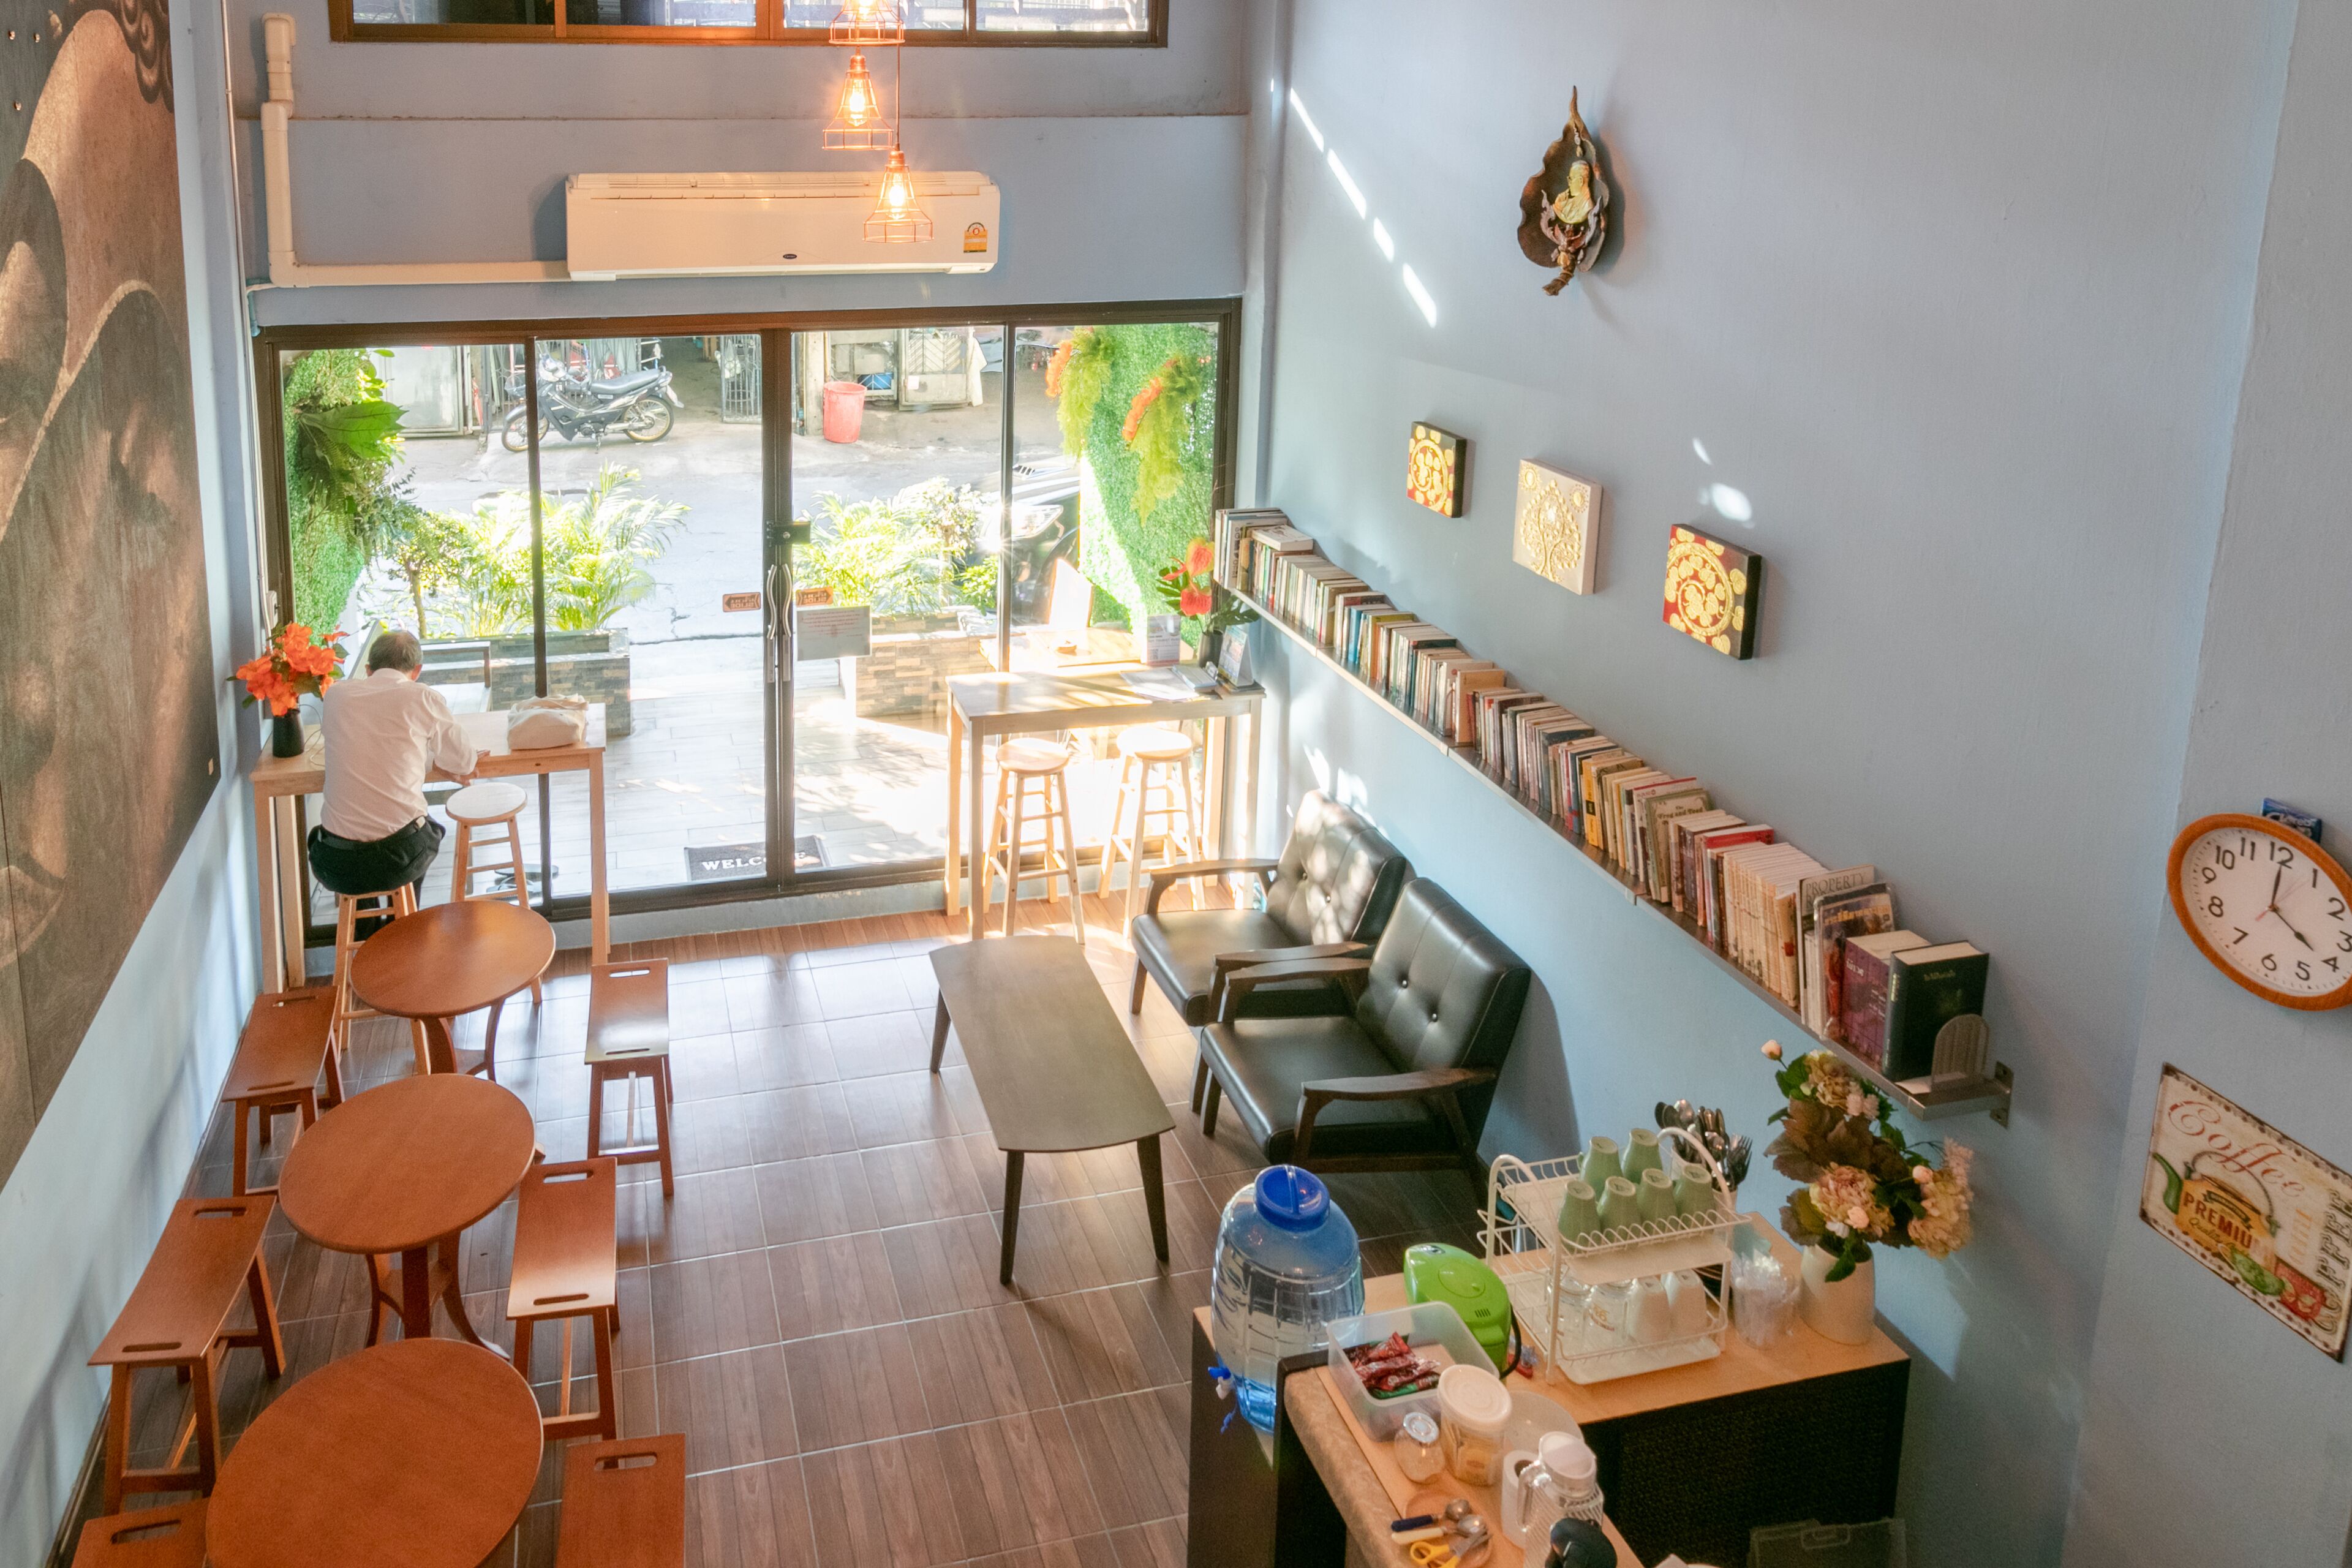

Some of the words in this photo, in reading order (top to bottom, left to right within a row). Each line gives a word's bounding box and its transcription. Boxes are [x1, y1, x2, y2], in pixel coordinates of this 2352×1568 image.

[2215, 845, 2235, 870] 10
[2241, 837, 2256, 861] 11
[2270, 841, 2294, 869] 12
[701, 851, 806, 871] WELCE
[1806, 872, 1866, 895] PROPERTY
[2202, 867, 2217, 884] 9
[2312, 868, 2318, 888] 1
[2208, 896, 2224, 918] 8
[2328, 897, 2345, 921] 2
[2233, 927, 2248, 944] 7
[2336, 930, 2352, 952] 3
[2261, 954, 2277, 971] 6
[2295, 960, 2311, 981] 5
[2321, 956, 2340, 973] 4
[2168, 1101, 2305, 1197] Coffee
